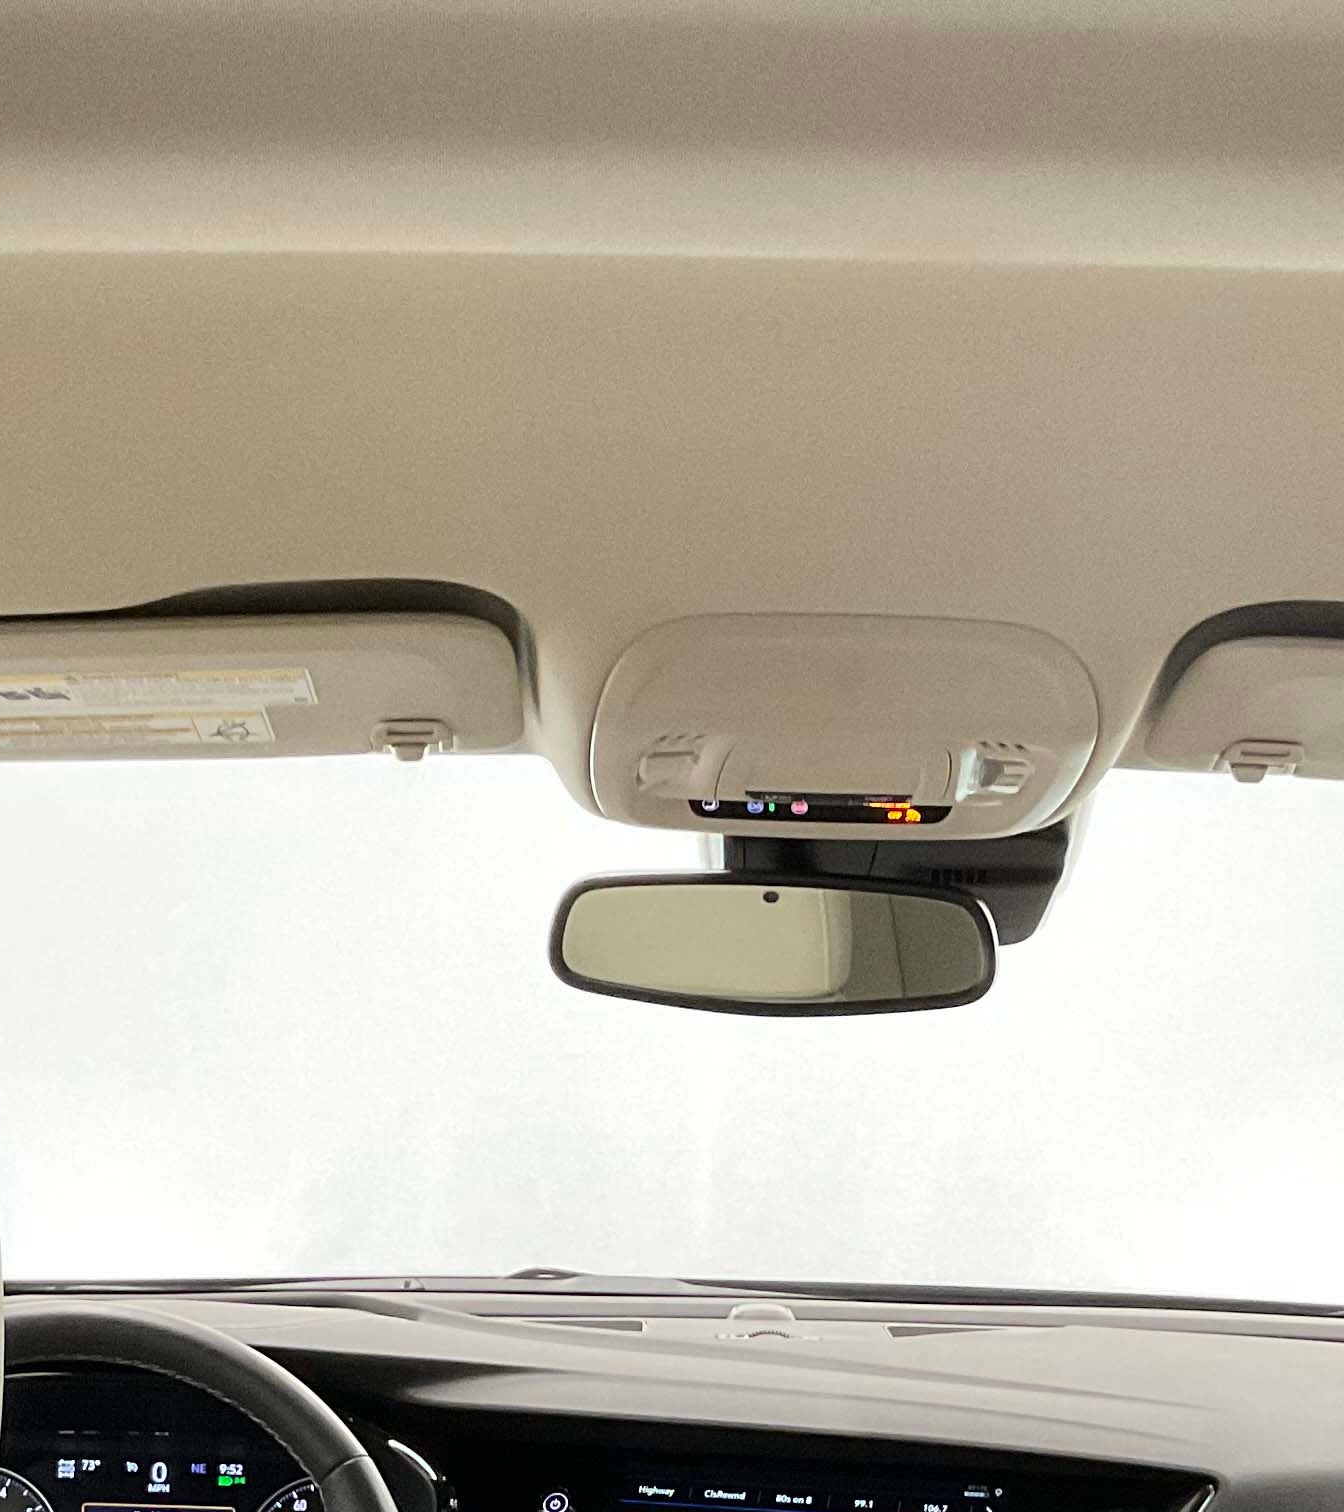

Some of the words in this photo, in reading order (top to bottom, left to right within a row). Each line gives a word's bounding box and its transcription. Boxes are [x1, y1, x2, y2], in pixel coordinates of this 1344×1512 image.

[151, 1461, 168, 1483] 0
[191, 1463, 207, 1474] NE
[219, 1463, 244, 1475] 9:52
[147, 1483, 171, 1493] MPH
[638, 1485, 675, 1497] Highway
[293, 1499, 307, 1512] 60
[854, 1499, 874, 1509] 99.1
